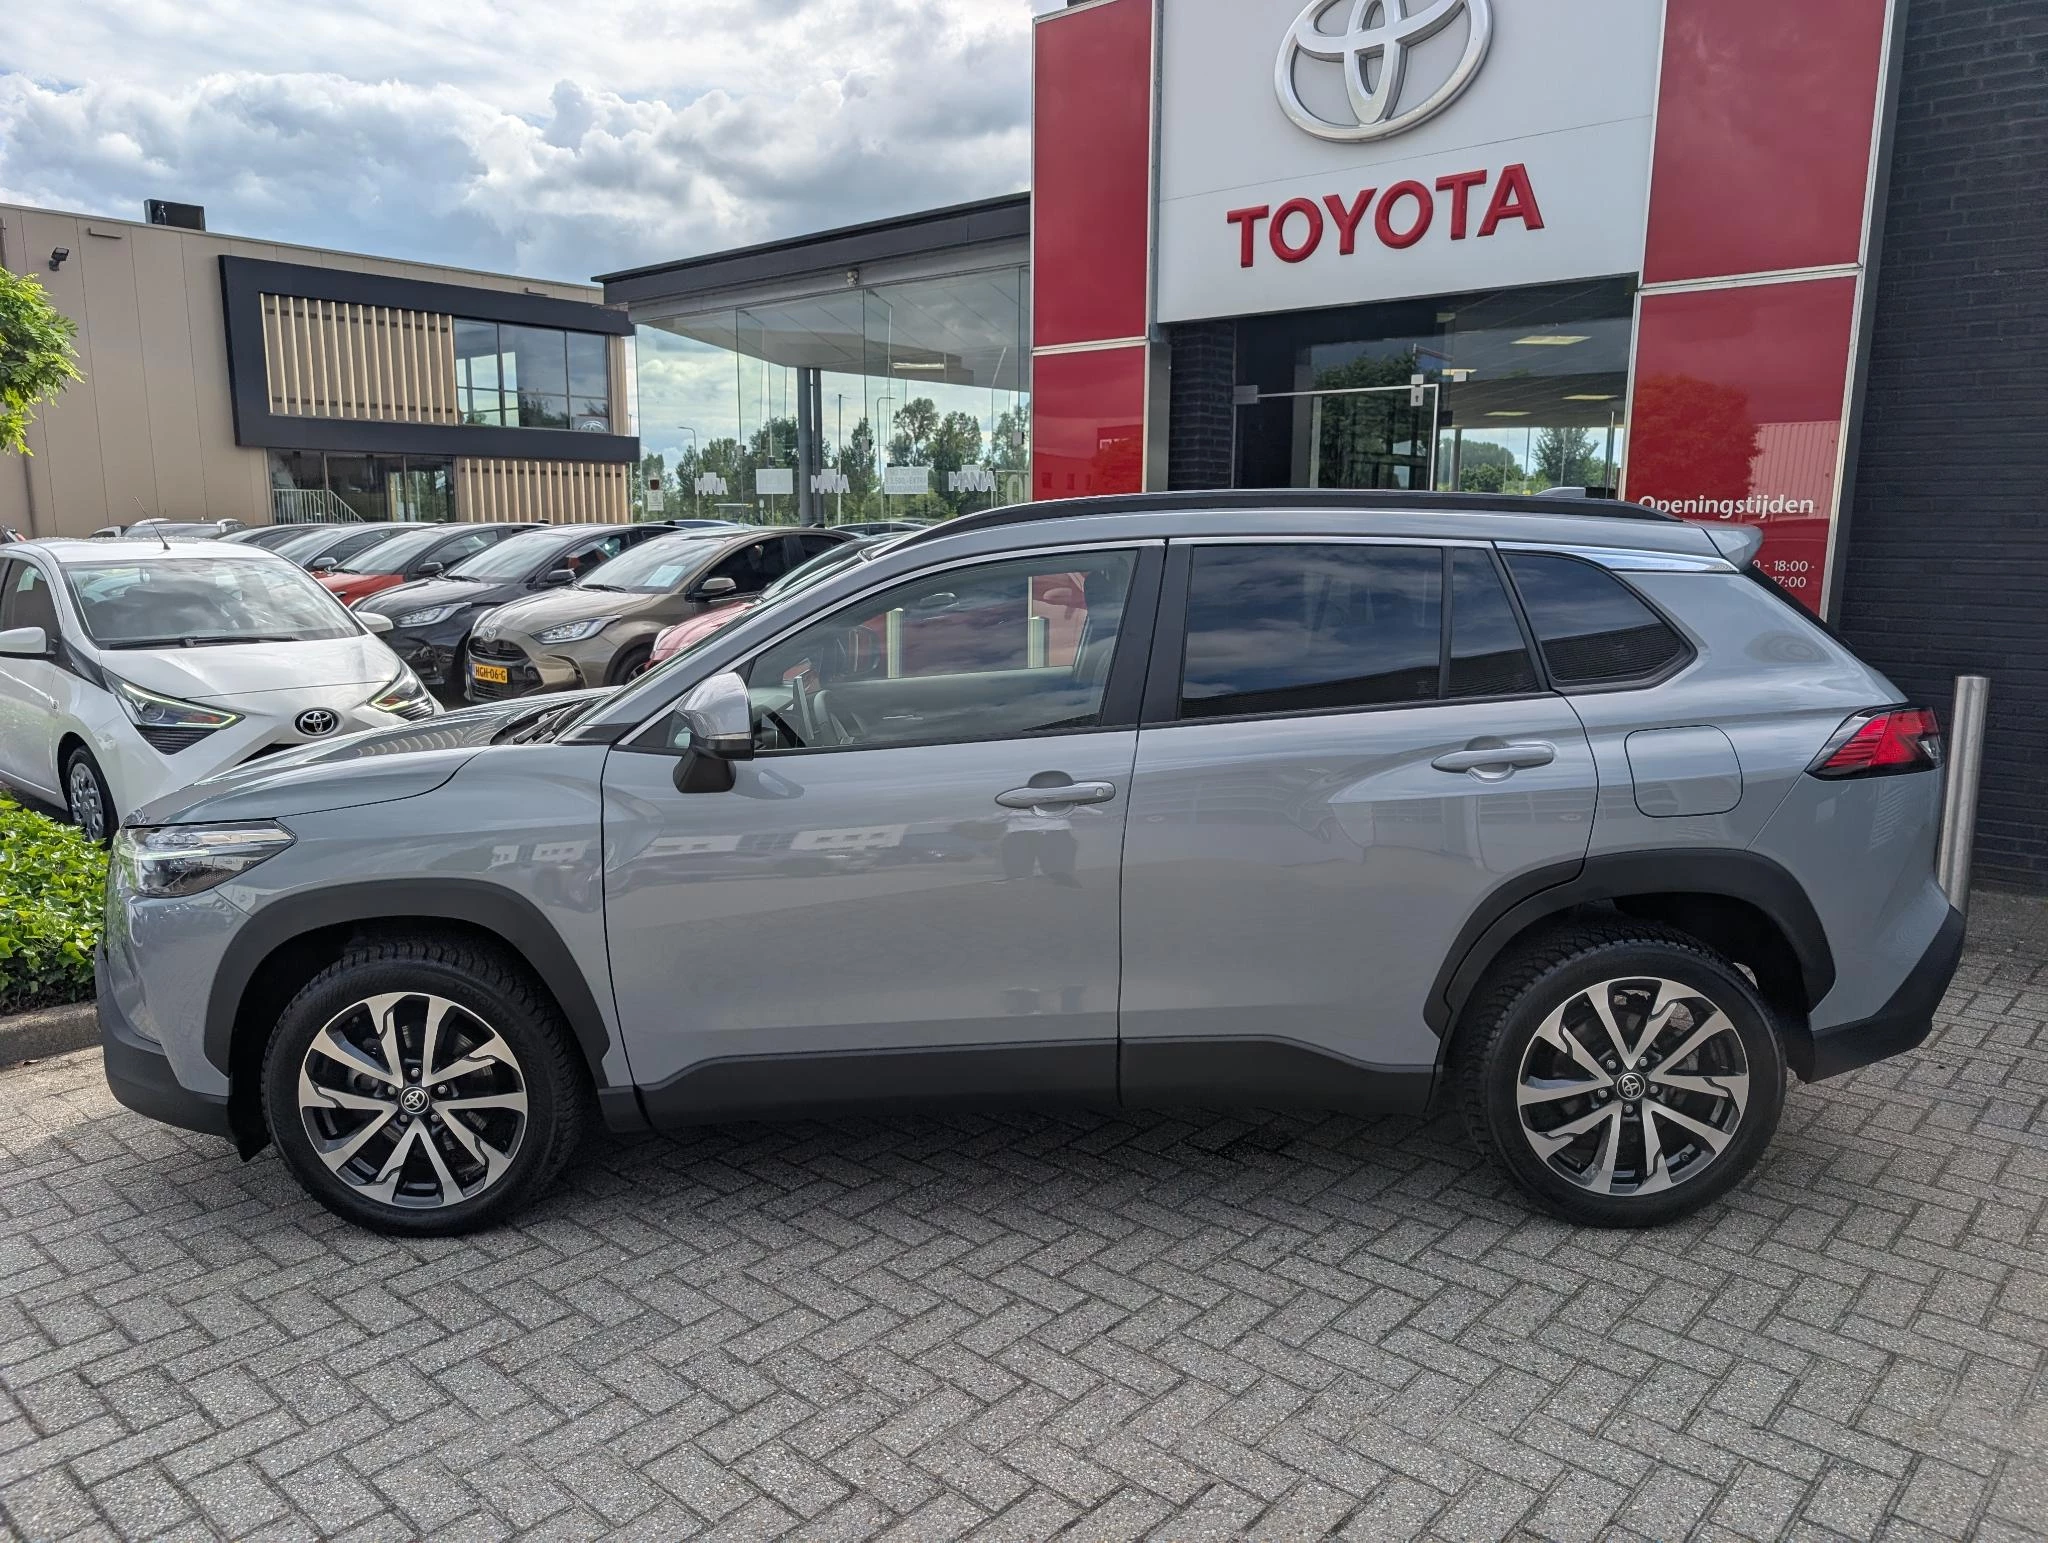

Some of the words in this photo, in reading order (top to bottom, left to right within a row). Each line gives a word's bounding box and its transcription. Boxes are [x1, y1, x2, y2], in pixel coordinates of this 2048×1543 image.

[1227, 163, 1544, 268] TOYOTA
[1639, 495, 1814, 519] Openingstijden
[1774, 560, 1808, 572] 18:00
